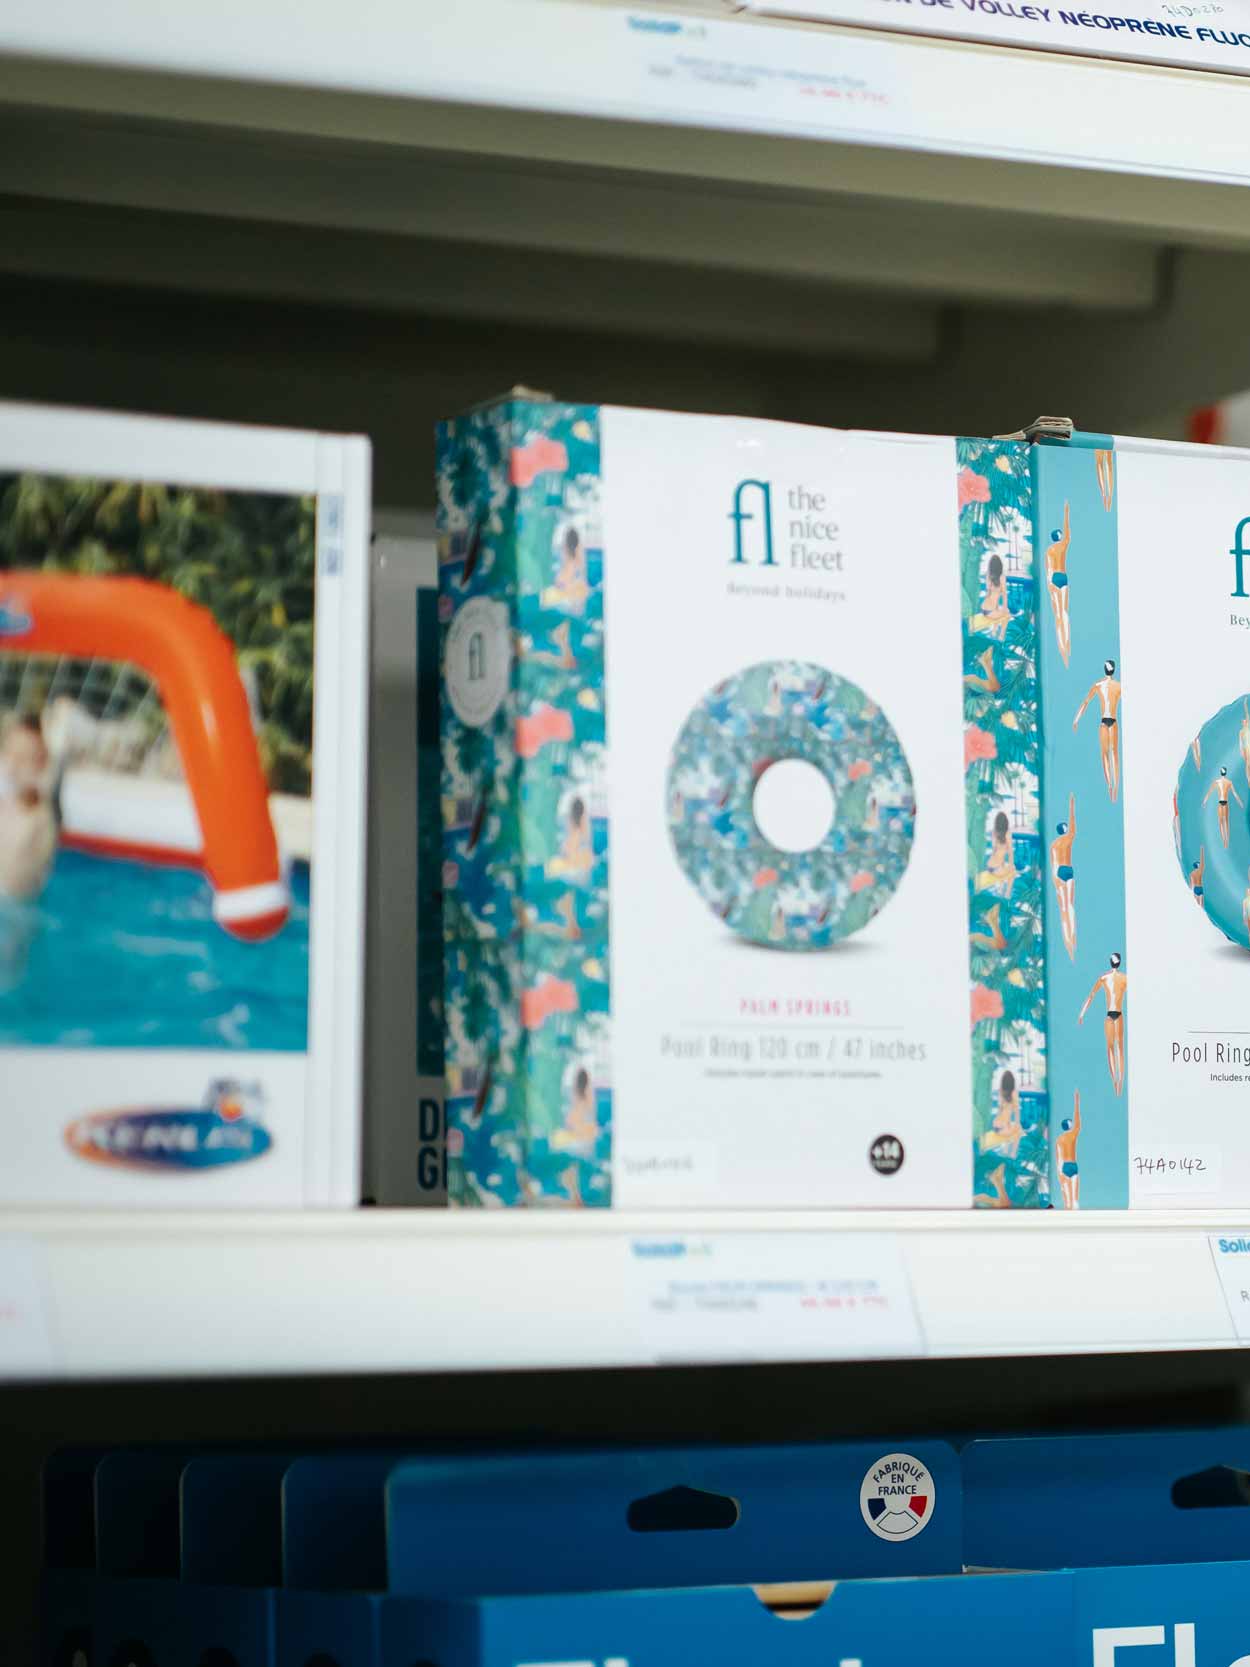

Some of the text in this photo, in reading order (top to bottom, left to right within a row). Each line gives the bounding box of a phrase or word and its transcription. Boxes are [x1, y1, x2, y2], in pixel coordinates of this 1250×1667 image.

[961, 0, 1050, 22] VOLLEY
[1059, 10, 1192, 39] NÉOPRÈNE
[788, 484, 826, 511] the
[788, 514, 839, 541] nice
[789, 543, 844, 571] fleet
[739, 999, 852, 1017] PALM SPRINGS
[661, 1036, 704, 1058] Pool
[709, 1037, 751, 1062] Ring
[759, 1037, 788, 1060] 120
[795, 1043, 820, 1060] cm
[843, 1039, 864, 1059] 47
[869, 1039, 927, 1062] inches
[1172, 1042, 1207, 1063] Pool
[1210, 1073, 1243, 1082] Includes
[1133, 1156, 1208, 1173] 74A0142
[891, 1473, 905, 1483] EN
[878, 1484, 917, 1496] FRANCE
